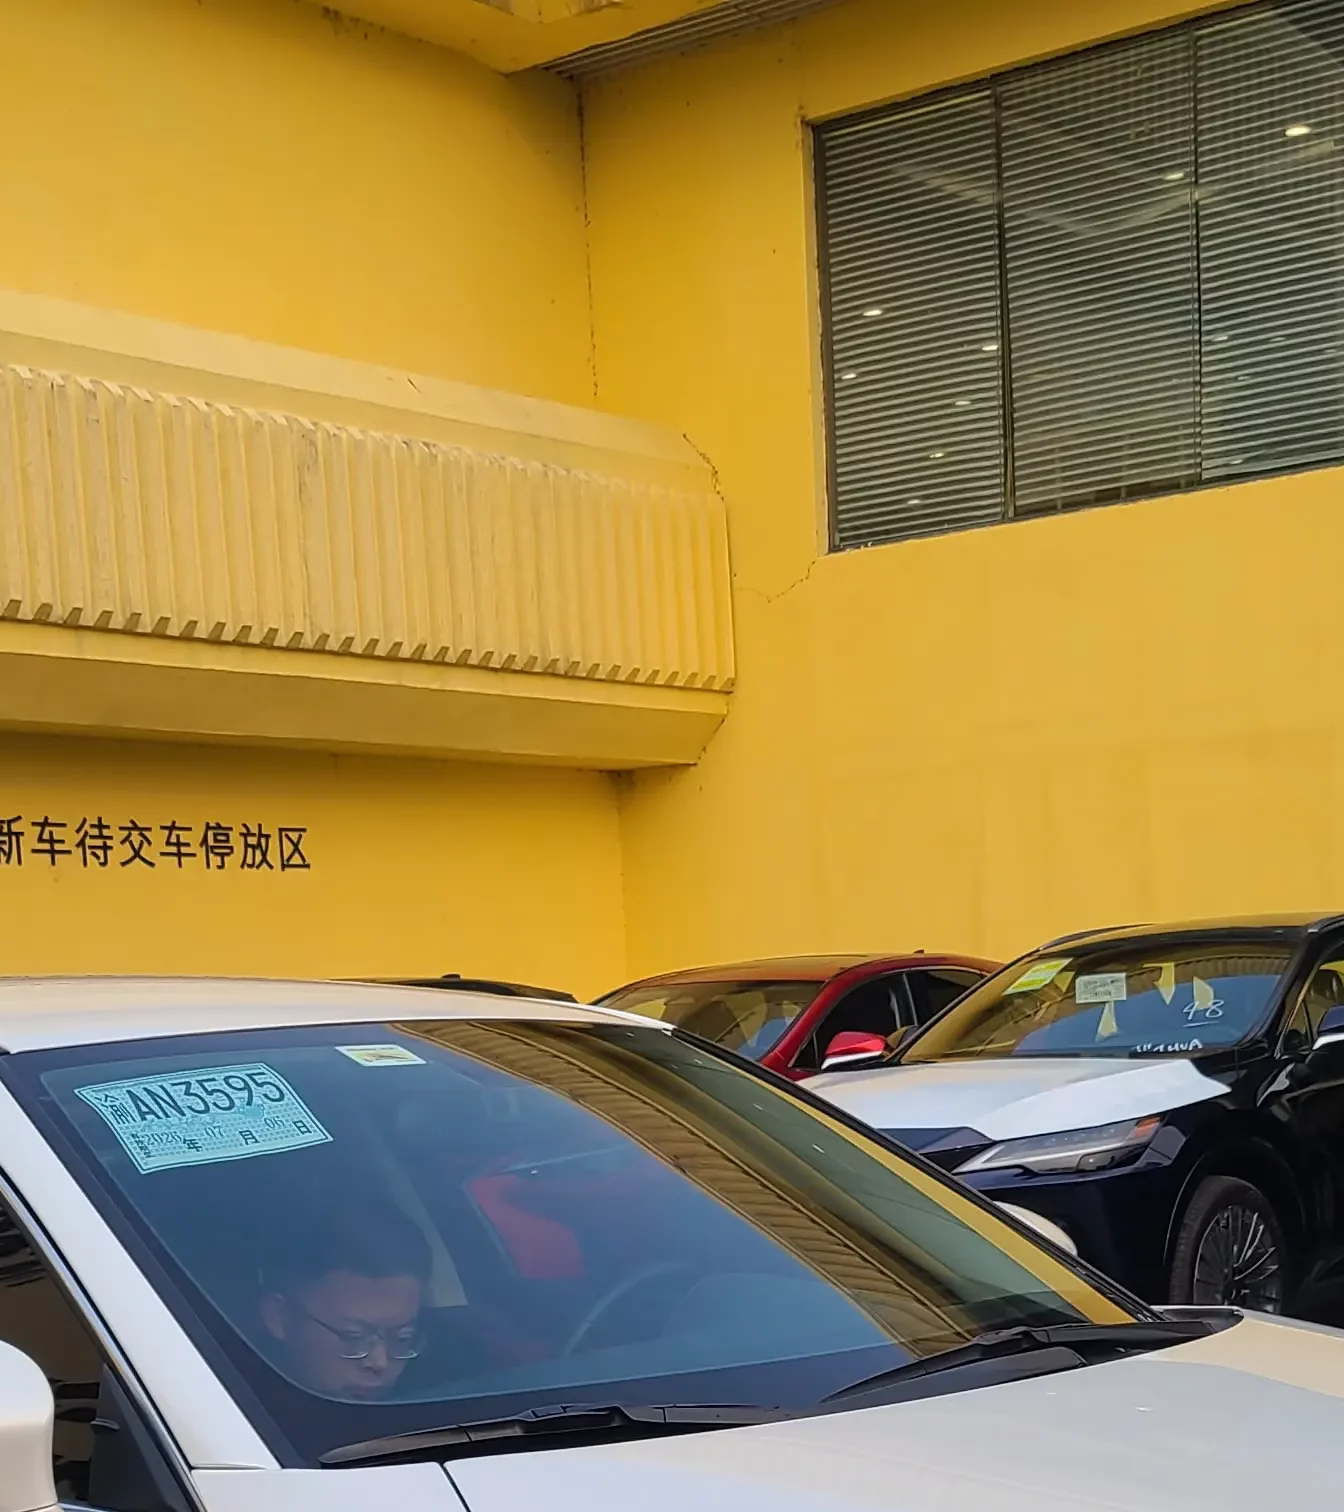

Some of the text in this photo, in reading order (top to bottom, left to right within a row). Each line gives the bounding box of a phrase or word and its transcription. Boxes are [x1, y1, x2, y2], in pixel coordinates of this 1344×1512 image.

[1182, 999, 1226, 1021] 48
[183, 1138, 203, 1152] 年
[204, 1125, 225, 1140] 07
[239, 1129, 260, 1145] 月
[264, 1116, 285, 1129] 06
[294, 1120, 313, 1135] 日
